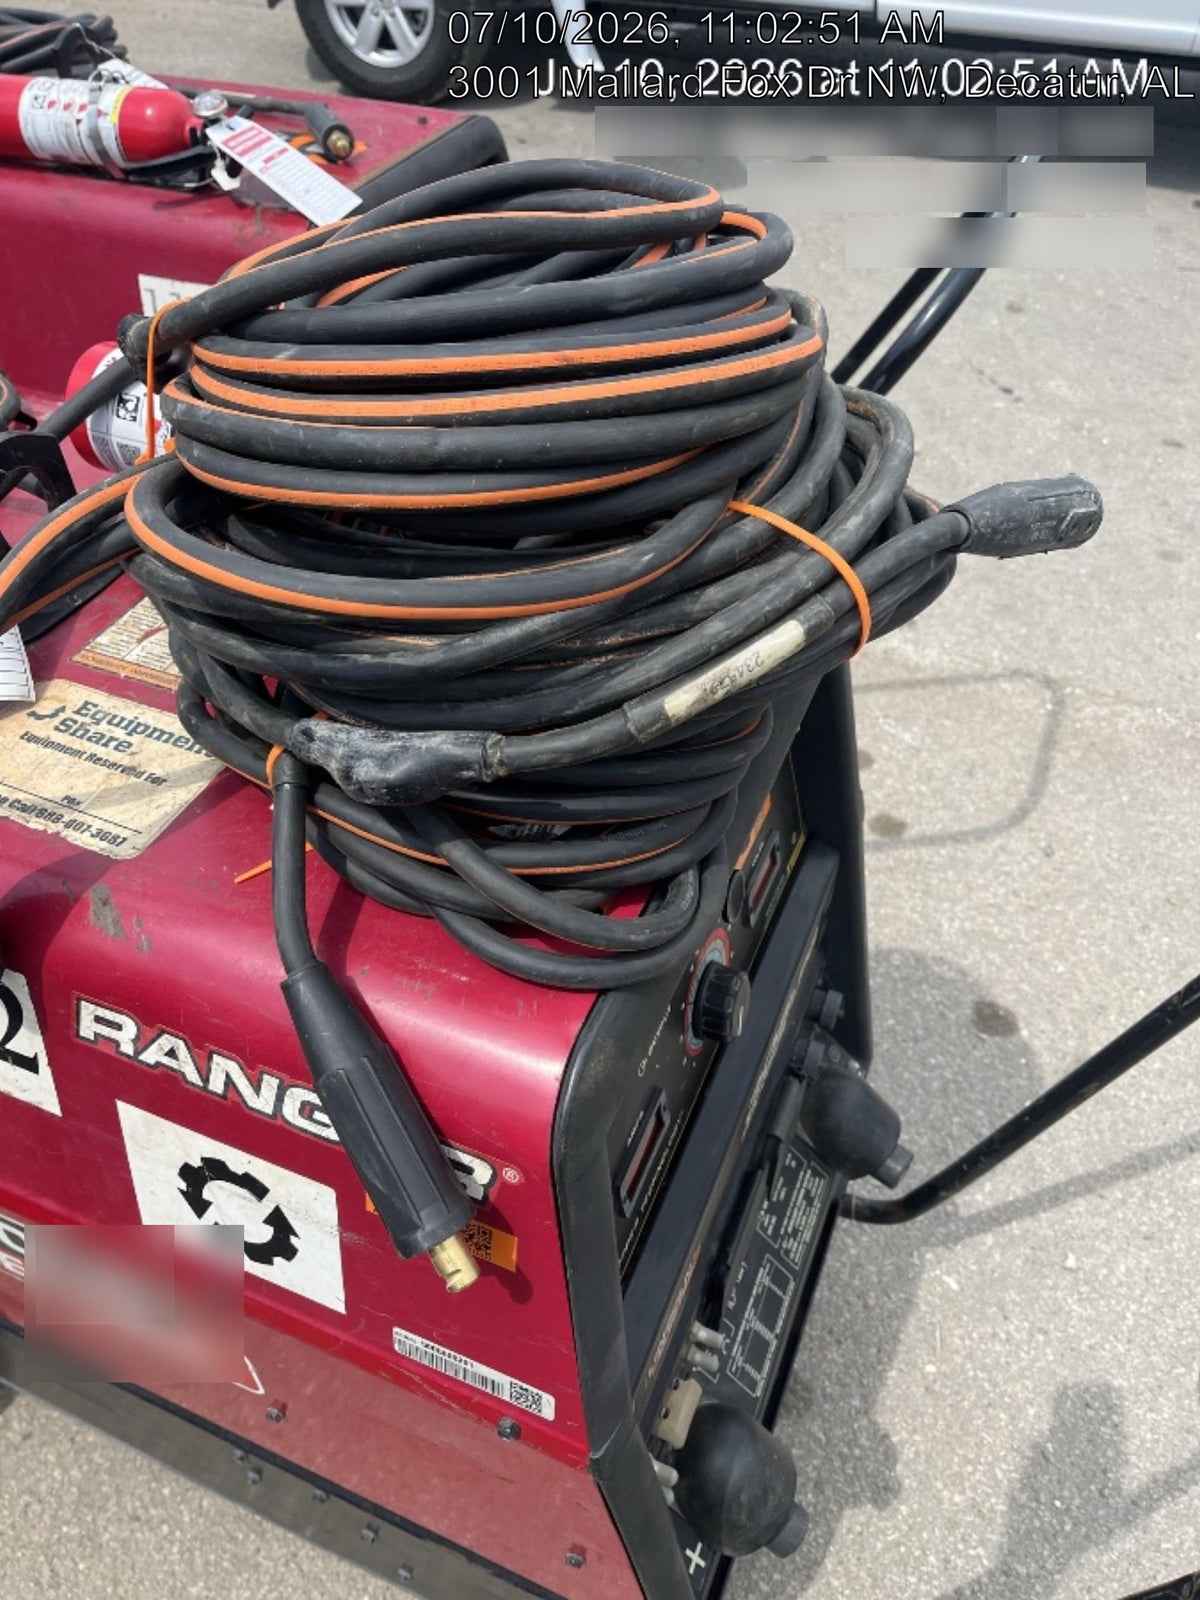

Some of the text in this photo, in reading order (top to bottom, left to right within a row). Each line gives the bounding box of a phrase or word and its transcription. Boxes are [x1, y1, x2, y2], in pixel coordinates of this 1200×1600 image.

[53, 716, 134, 753] Share
[72, 700, 215, 758] Equipmen
[19, 730, 168, 787] Equipment Reserved For
[77, 998, 495, 1203] RANGR
